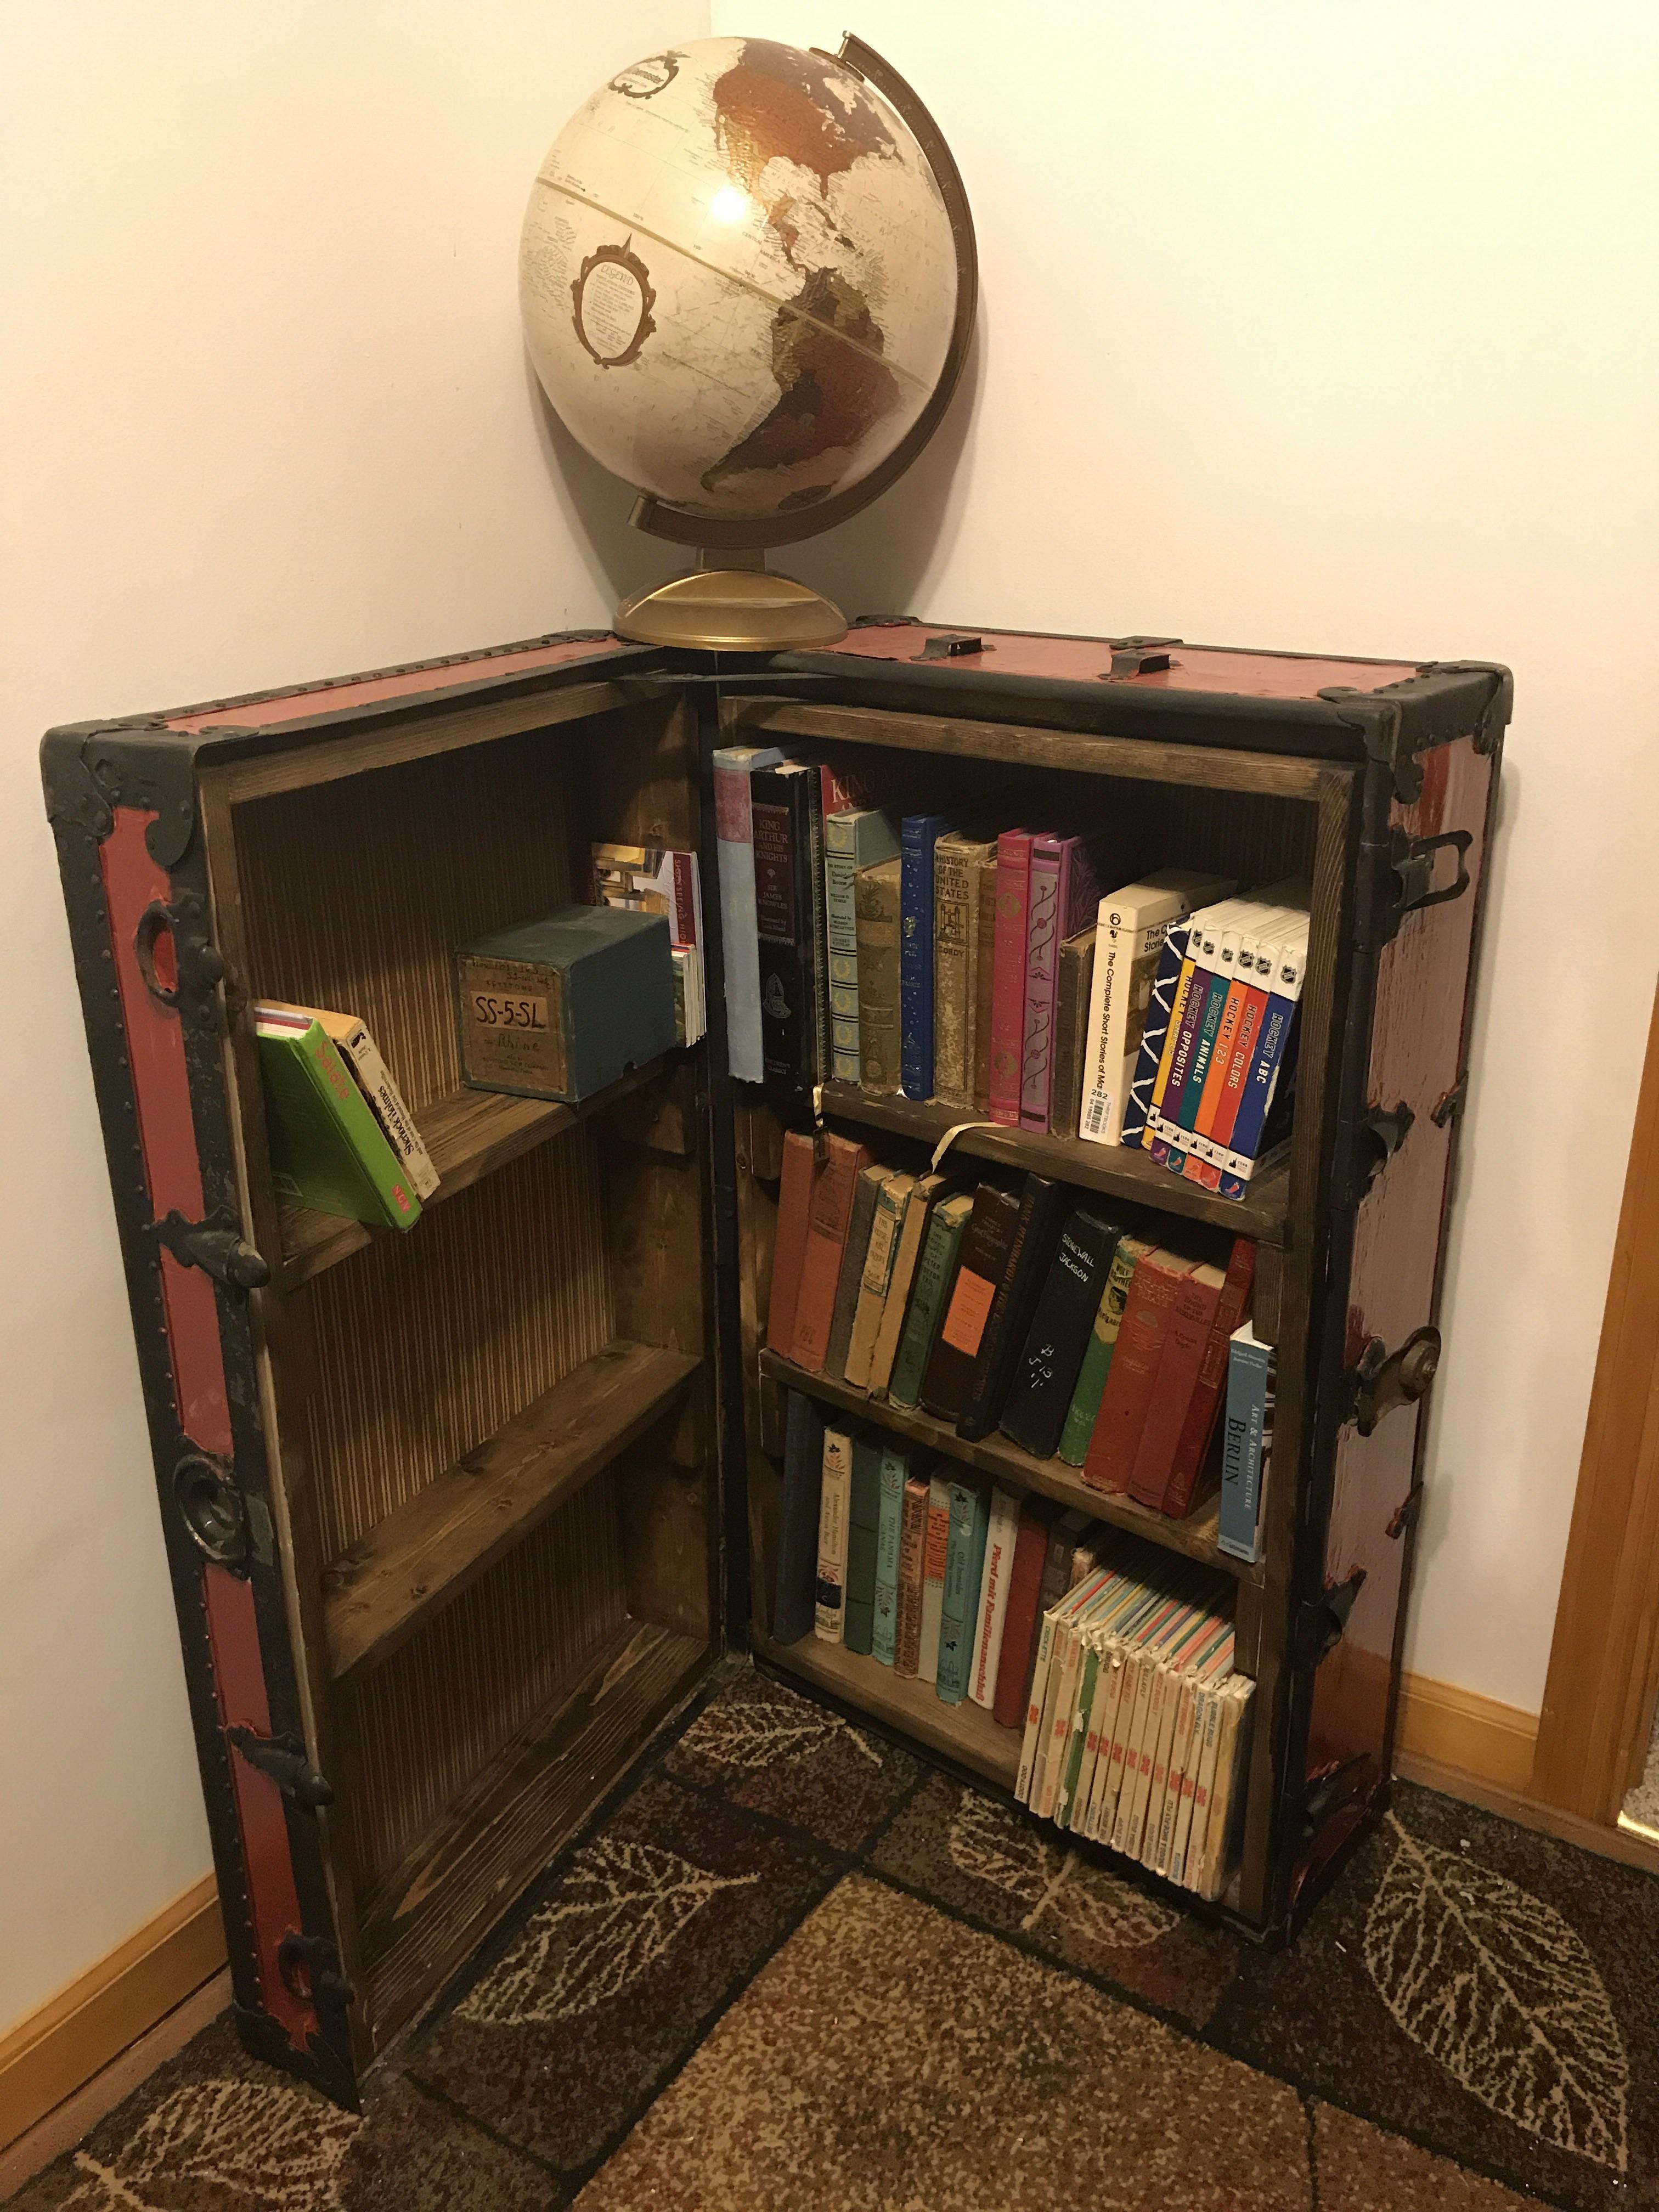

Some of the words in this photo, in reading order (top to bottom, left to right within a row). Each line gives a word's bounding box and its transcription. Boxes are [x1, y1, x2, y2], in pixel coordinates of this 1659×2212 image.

[601, 264, 634, 285] LEGEND
[754, 830, 788, 844] ARTHUR
[759, 819, 780, 831] KING
[756, 850, 788, 863] KNIGHTS
[940, 856, 969, 867] HISTORY
[935, 875, 969, 889] UNITED
[938, 865, 947, 874] OF
[949, 867, 963, 878] THE
[935, 885, 969, 900] STATES
[1144, 939, 1164, 952] Storie
[1147, 929, 1159, 940] The
[1108, 952, 1116, 967] The
[1104, 968, 1115, 1012] Complete
[476, 996, 546, 1029] SS-5-SL
[1185, 984, 1204, 1029] HOCKEY
[1204, 992, 1223, 1037] HOCKEY
[1222, 997, 1240, 1040] HOCKEY
[1101, 1013, 1110, 1035] Short
[1239, 1005, 1257, 1049] HOCKEY
[1262, 1013, 1283, 1059] HOCKEY
[1099, 1035, 1108, 1064] Stories
[1171, 1030, 1192, 1087] OPPOSITES
[1193, 1039, 1210, 1084] ANIMALS
[1097, 1075, 1105, 1090] Ma
[1098, 1065, 1105, 1074] of
[1228, 1051, 1245, 1089] COLORS
[1256, 1060, 1271, 1084] ABC
[378, 1086, 397, 1120] Holmes
[1091, 1090, 1108, 1100] 282
[393, 1117, 414, 1155] Sherlock
[1062, 1233, 1094, 1268] STONEWALL
[1058, 1252, 1089, 1283] JACKSON
[1250, 1404, 1260, 1424] ART
[1250, 1427, 1259, 1437] &
[1224, 1417, 1246, 1485] BERLIN
[1244, 1438, 1257, 1510] ARCHITECTURE
[887, 1535, 895, 1568] PANAMA
[989, 1543, 1002, 1578] Pferd
[987, 1578, 996, 1600] mit
[1195, 1691, 1205, 1721] DRAGON
[1193, 1722, 1202, 1735] FLY
